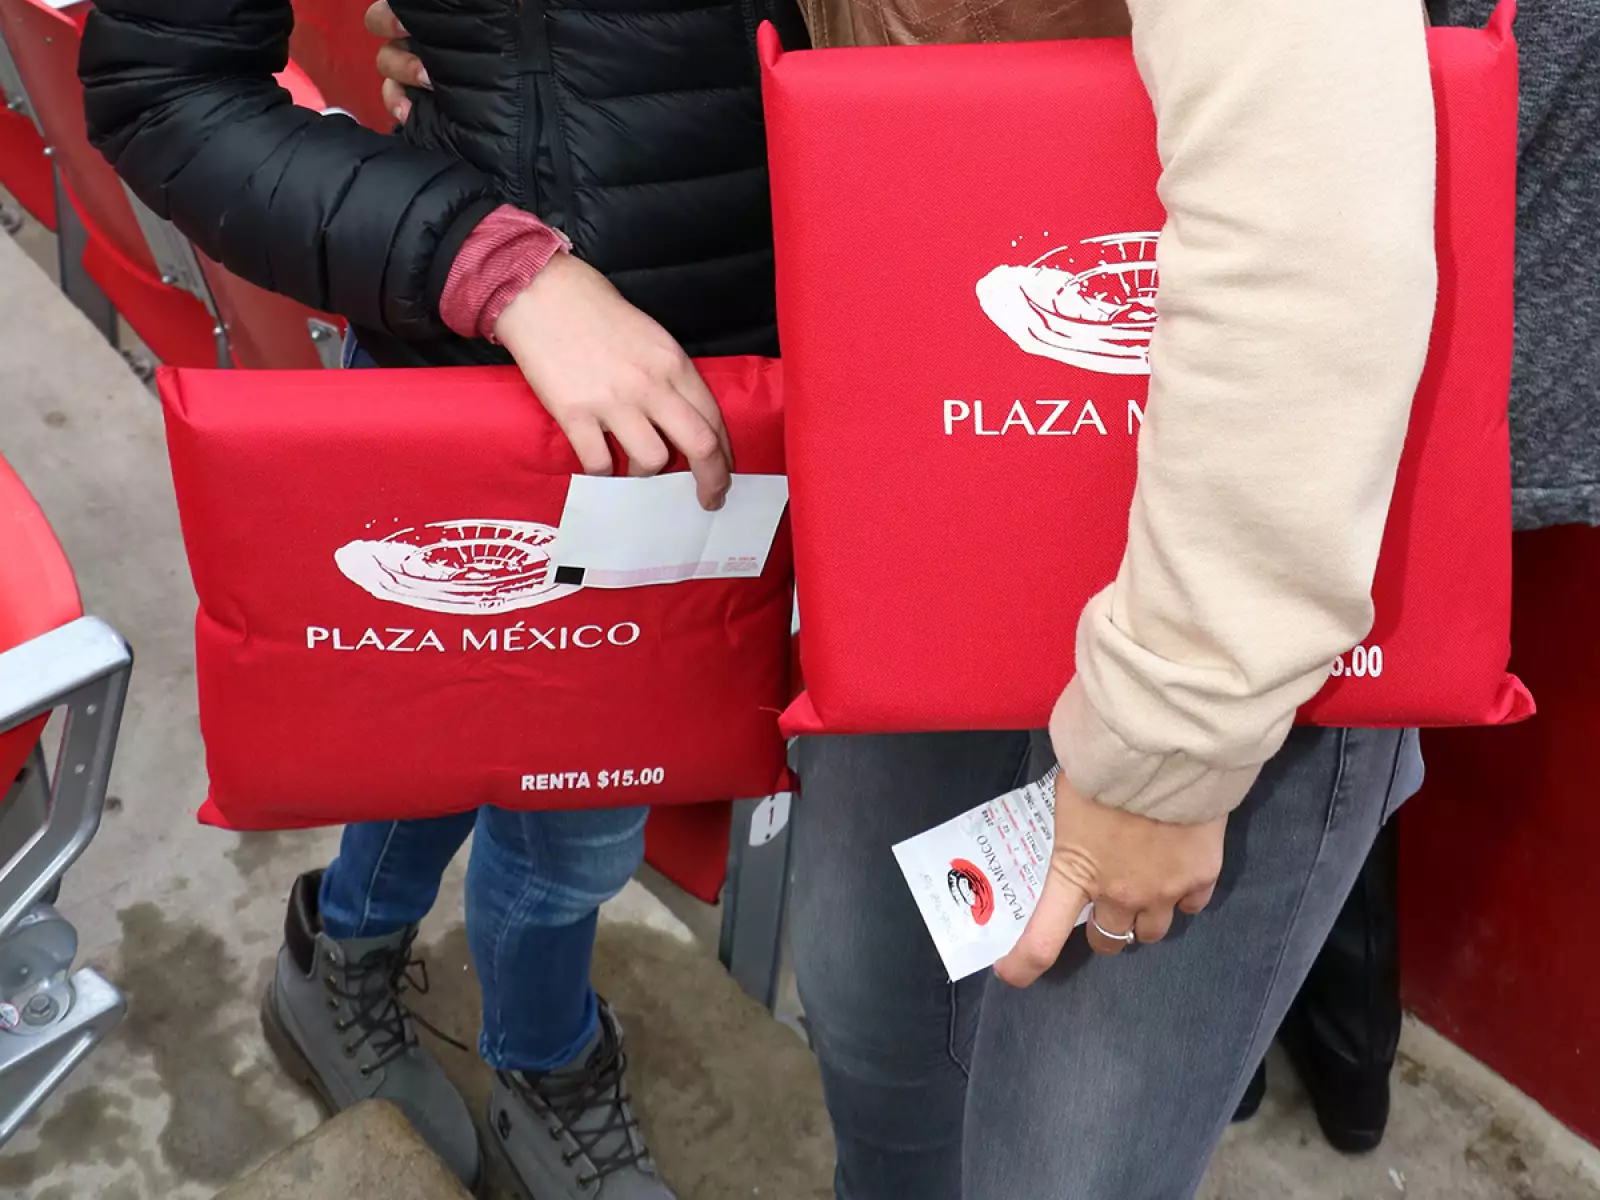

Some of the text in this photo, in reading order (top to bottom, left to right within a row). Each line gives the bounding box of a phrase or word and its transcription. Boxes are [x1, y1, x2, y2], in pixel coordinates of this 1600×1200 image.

[944, 399, 1108, 436] PLAZA
[306, 621, 641, 652] PLAZA MÉXICO
[521, 767, 665, 791] RENTA $15.00
[975, 834, 1005, 882] MÉXICO
[999, 882, 1025, 921] PLAZA
